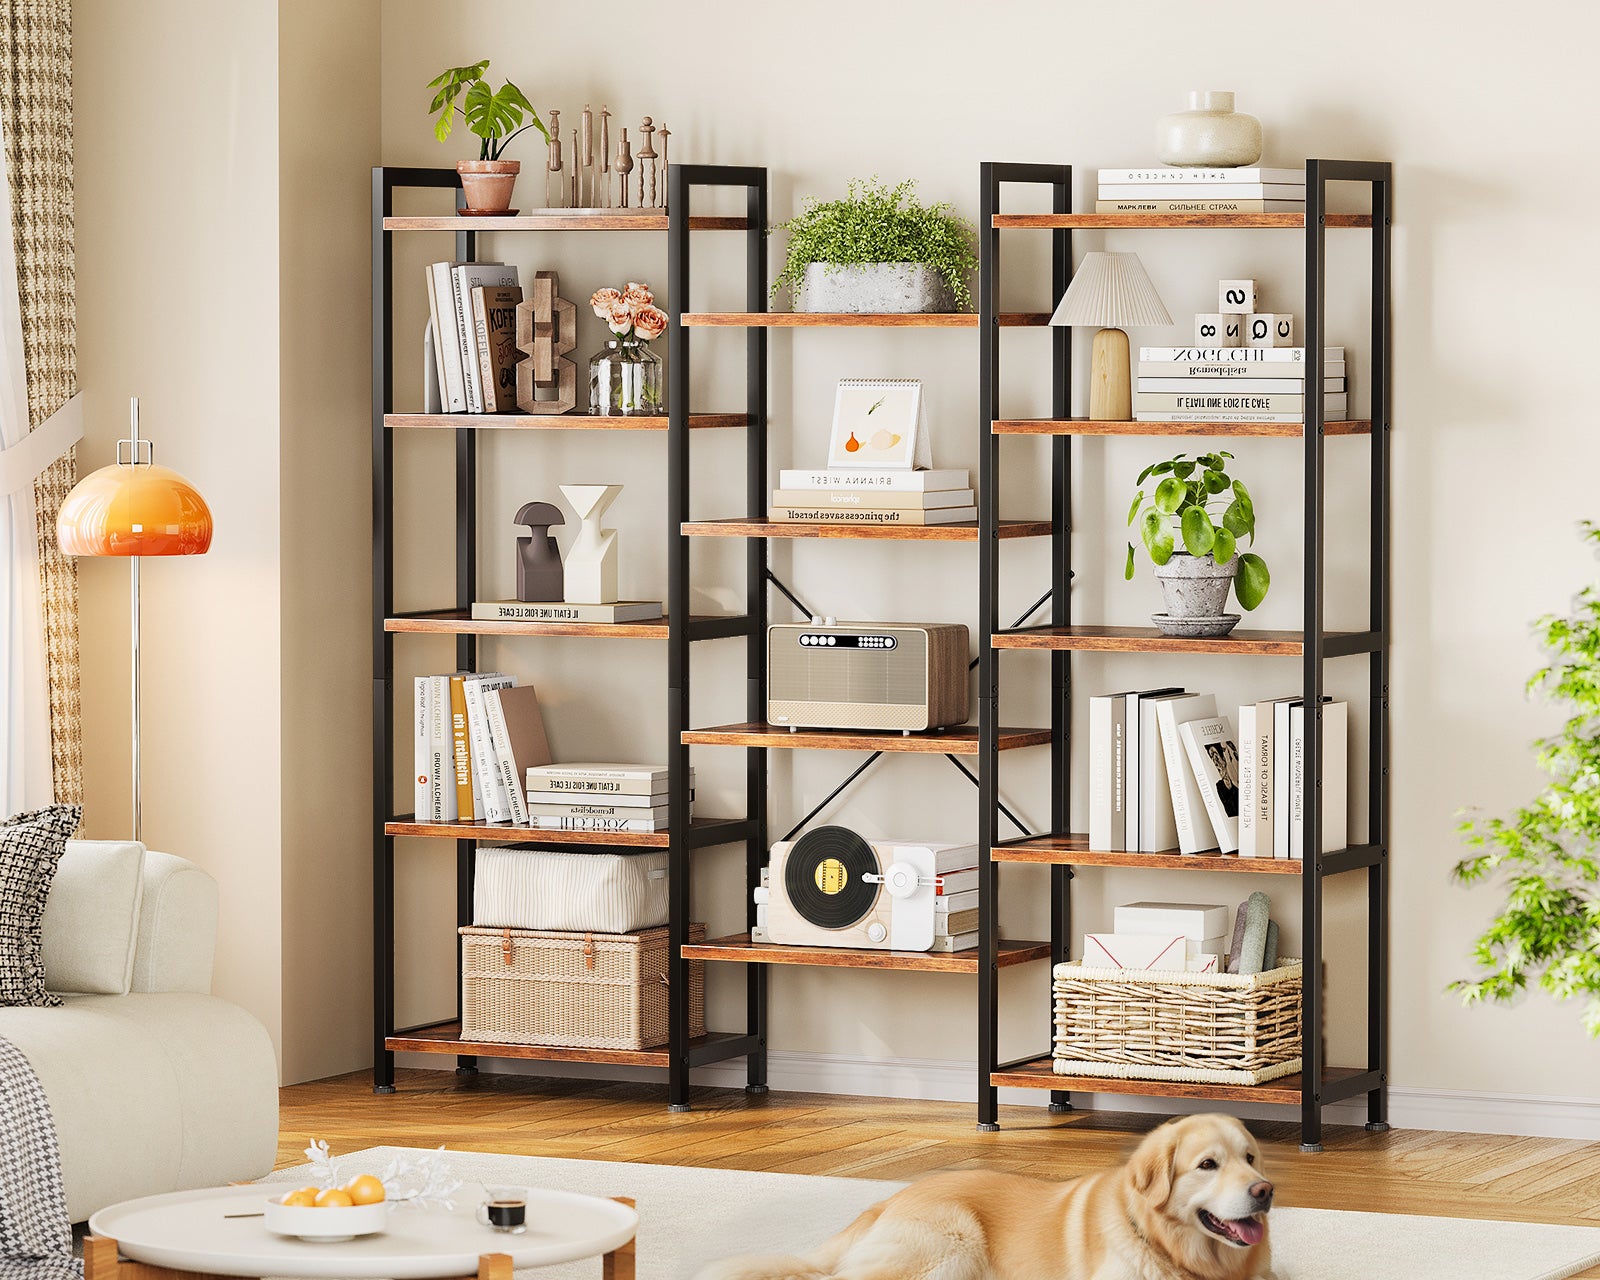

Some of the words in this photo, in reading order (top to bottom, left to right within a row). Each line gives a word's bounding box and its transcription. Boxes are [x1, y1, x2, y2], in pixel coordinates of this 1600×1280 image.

[1169, 203, 1206, 211] СИЛЬНЕЕ
[1209, 203, 1238, 211] СТРАХА
[498, 277, 516, 287] LEVEN
[475, 319, 489, 358] KOFFIE
[433, 699, 441, 739] ALCHEMIST
[492, 712, 506, 750] ALCHEMIST
[433, 752, 441, 780] GROWN
[456, 740, 469, 785] architecture
[502, 760, 513, 787] GROWN
